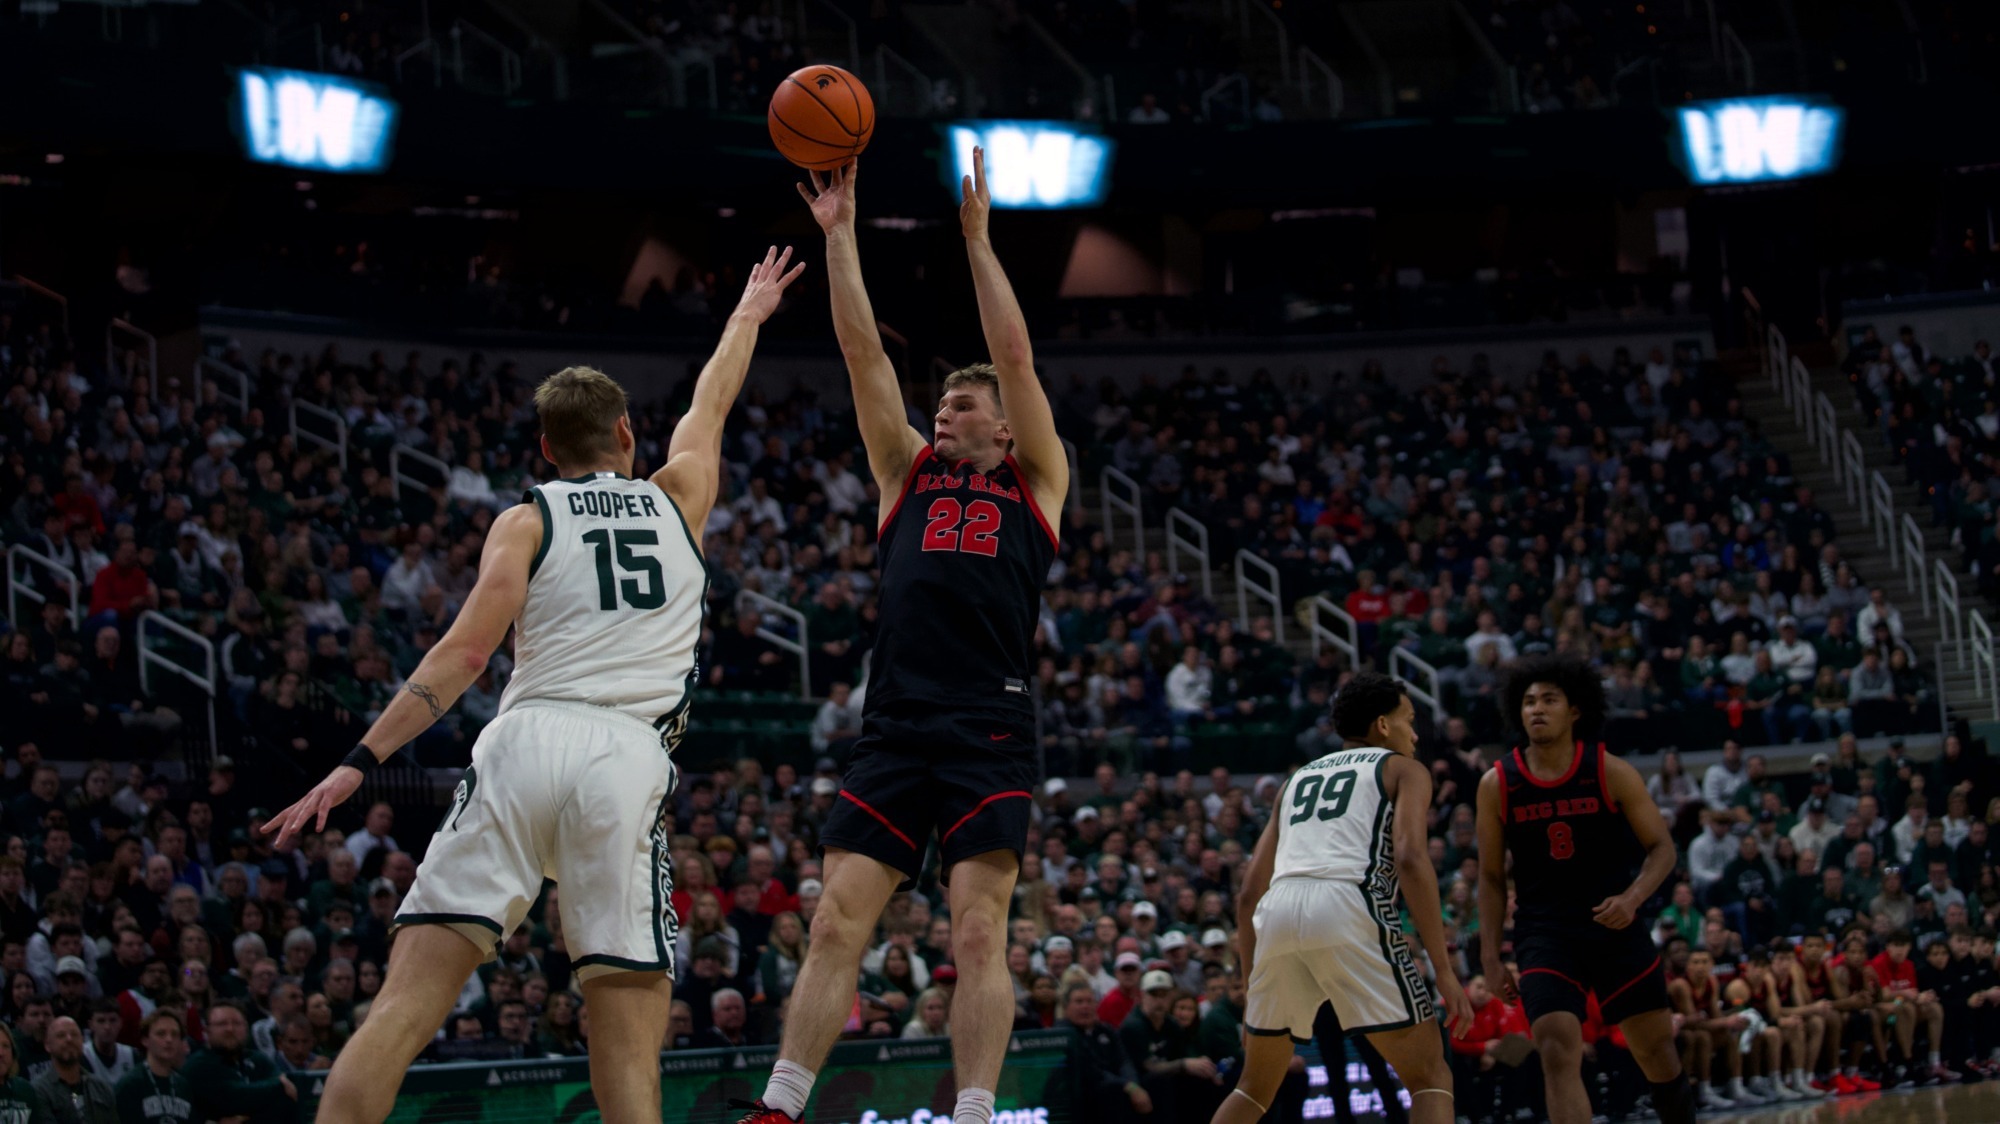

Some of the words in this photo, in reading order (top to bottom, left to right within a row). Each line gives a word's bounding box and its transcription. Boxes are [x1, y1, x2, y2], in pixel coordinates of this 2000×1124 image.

[568, 490, 661, 518] COOPER
[921, 497, 1002, 557] 22
[582, 529, 666, 611] 15
[1290, 769, 1358, 826] 99
[1512, 802, 1554, 824] BIG
[1555, 796, 1600, 816] RED
[1546, 821, 1576, 860] 8
